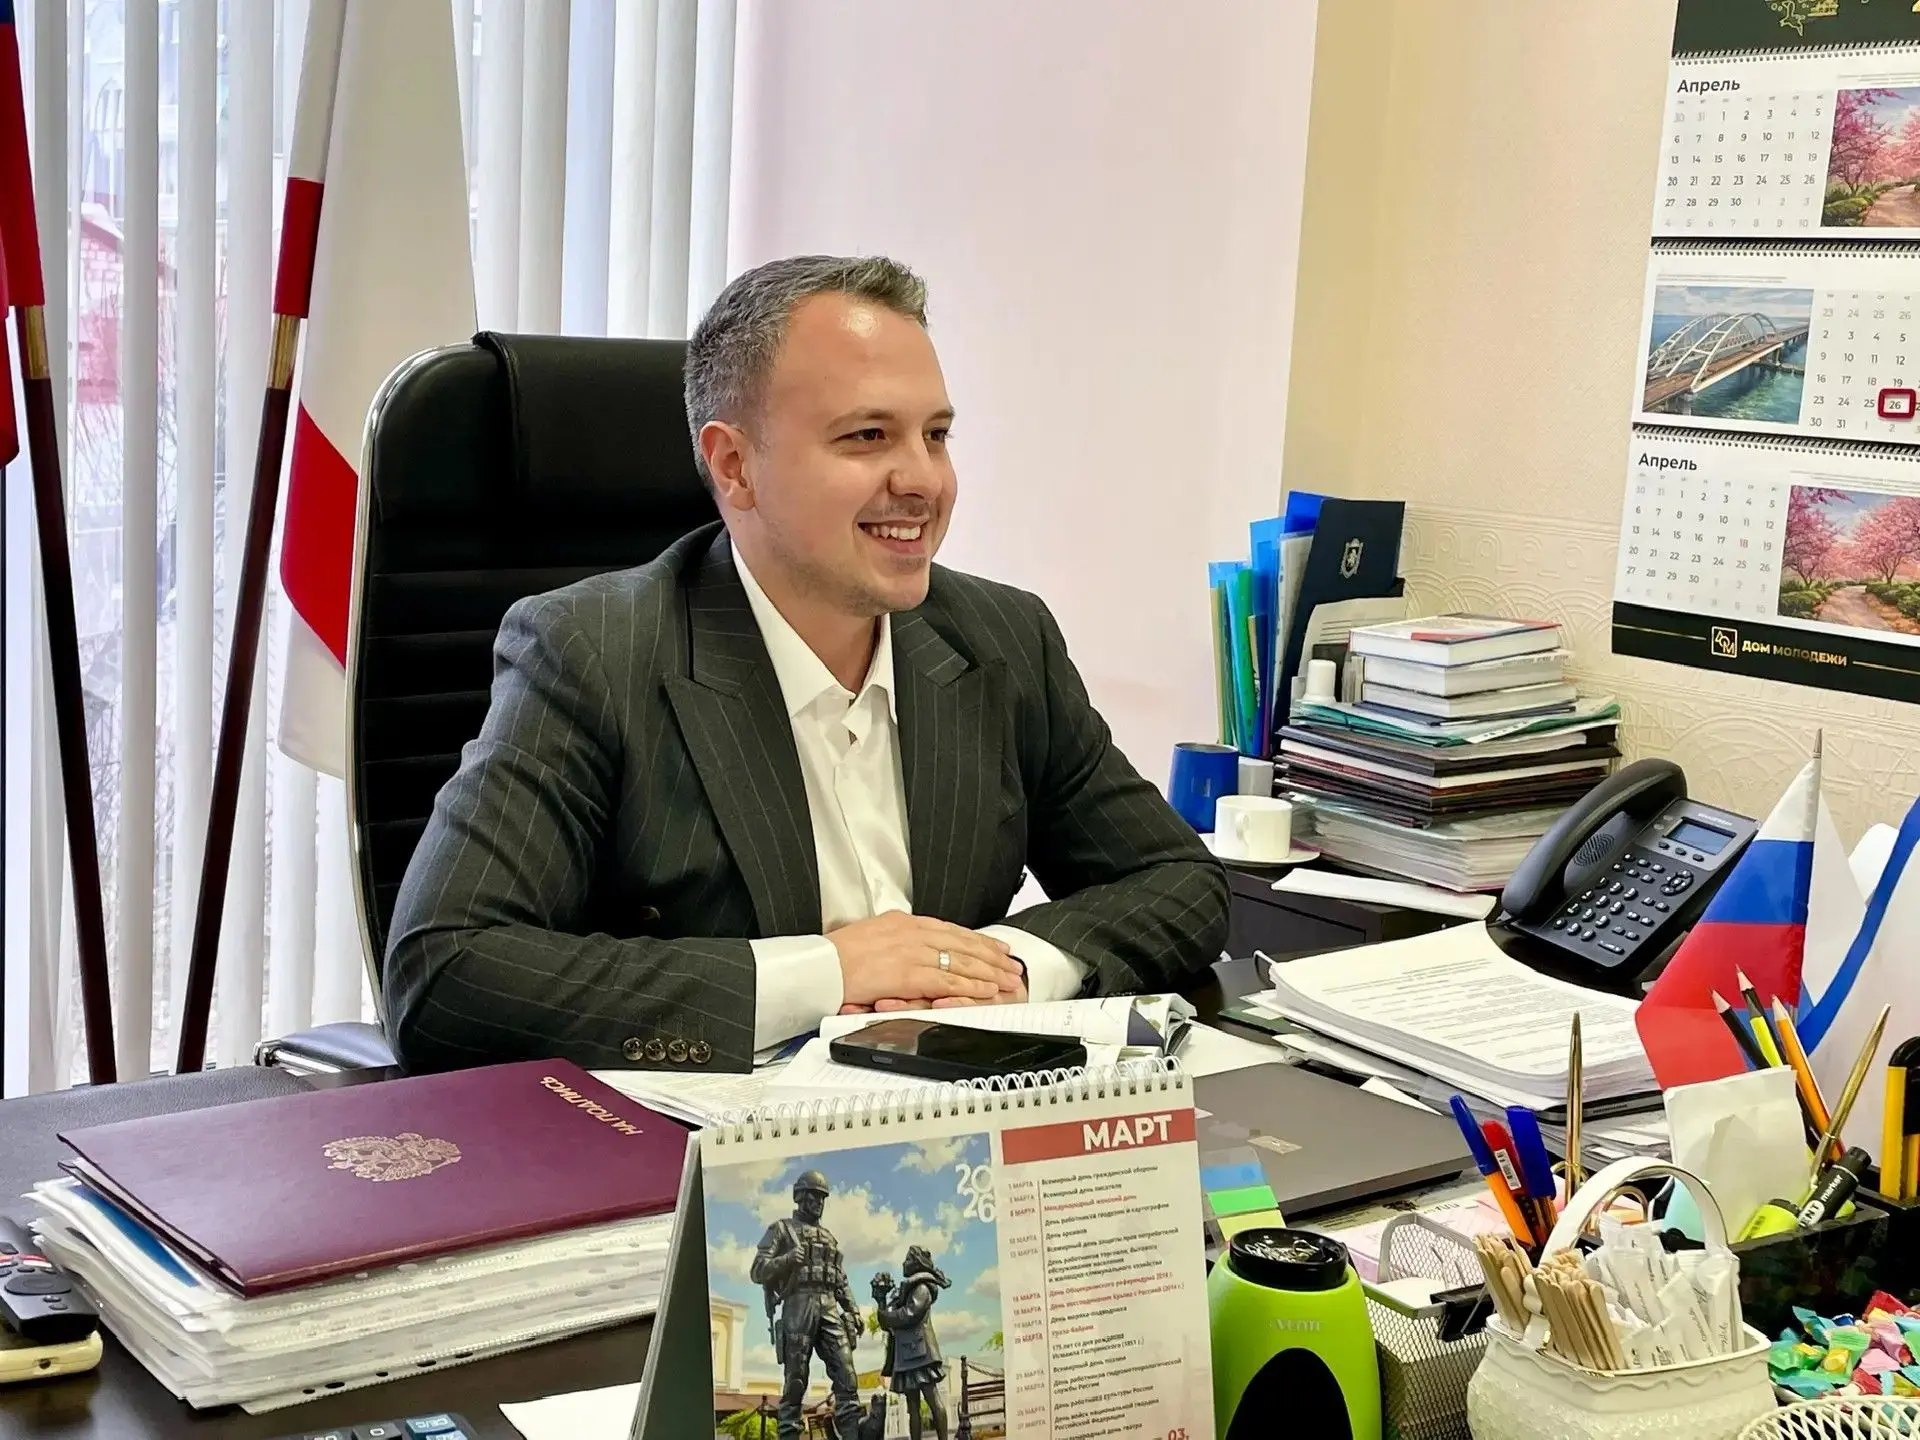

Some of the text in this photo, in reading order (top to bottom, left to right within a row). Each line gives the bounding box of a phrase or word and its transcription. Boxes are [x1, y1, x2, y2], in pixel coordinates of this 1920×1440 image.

[1677, 79, 1740, 95] Апрель
[1762, 131, 1773, 142] 10
[1787, 131, 1795, 141] 11
[1811, 130, 1820, 140] 12
[1671, 152, 1818, 165] 13 14 15 16 17 18 19
[1667, 174, 1816, 187] 20 21 22 23 24 25 26
[1664, 197, 1742, 208] 27 28 29 30
[1844, 352, 1855, 363] 10
[1871, 353, 1878, 364] 11
[1895, 355, 1906, 366] 12
[1816, 373, 1903, 387] 16 17 18 19
[1812, 395, 1825, 405] 23
[1837, 396, 1850, 407] 24
[1863, 398, 1876, 409] 25
[1889, 400, 1902, 410] 26
[1809, 416, 1823, 428] 30
[1836, 418, 1847, 429] 31
[1638, 452, 1698, 471] Апрель
[1719, 514, 1729, 525] 10
[1743, 517, 1750, 527] 11
[1765, 520, 1775, 530] 12
[1632, 525, 1772, 552] 13 14 15 16 17 18 19
[1628, 545, 1771, 573] 20 21 22 23 24 25 26
[1626, 565, 1700, 584] 27 28 29 30
[1742, 640, 1847, 666] ДОМ МОЛОДЕЖИ
[540, 1076, 643, 1135] НА ПОДПИСЬ
[1082, 1114, 1173, 1151] МАРТ
[1820, 1174, 1843, 1202] marker
